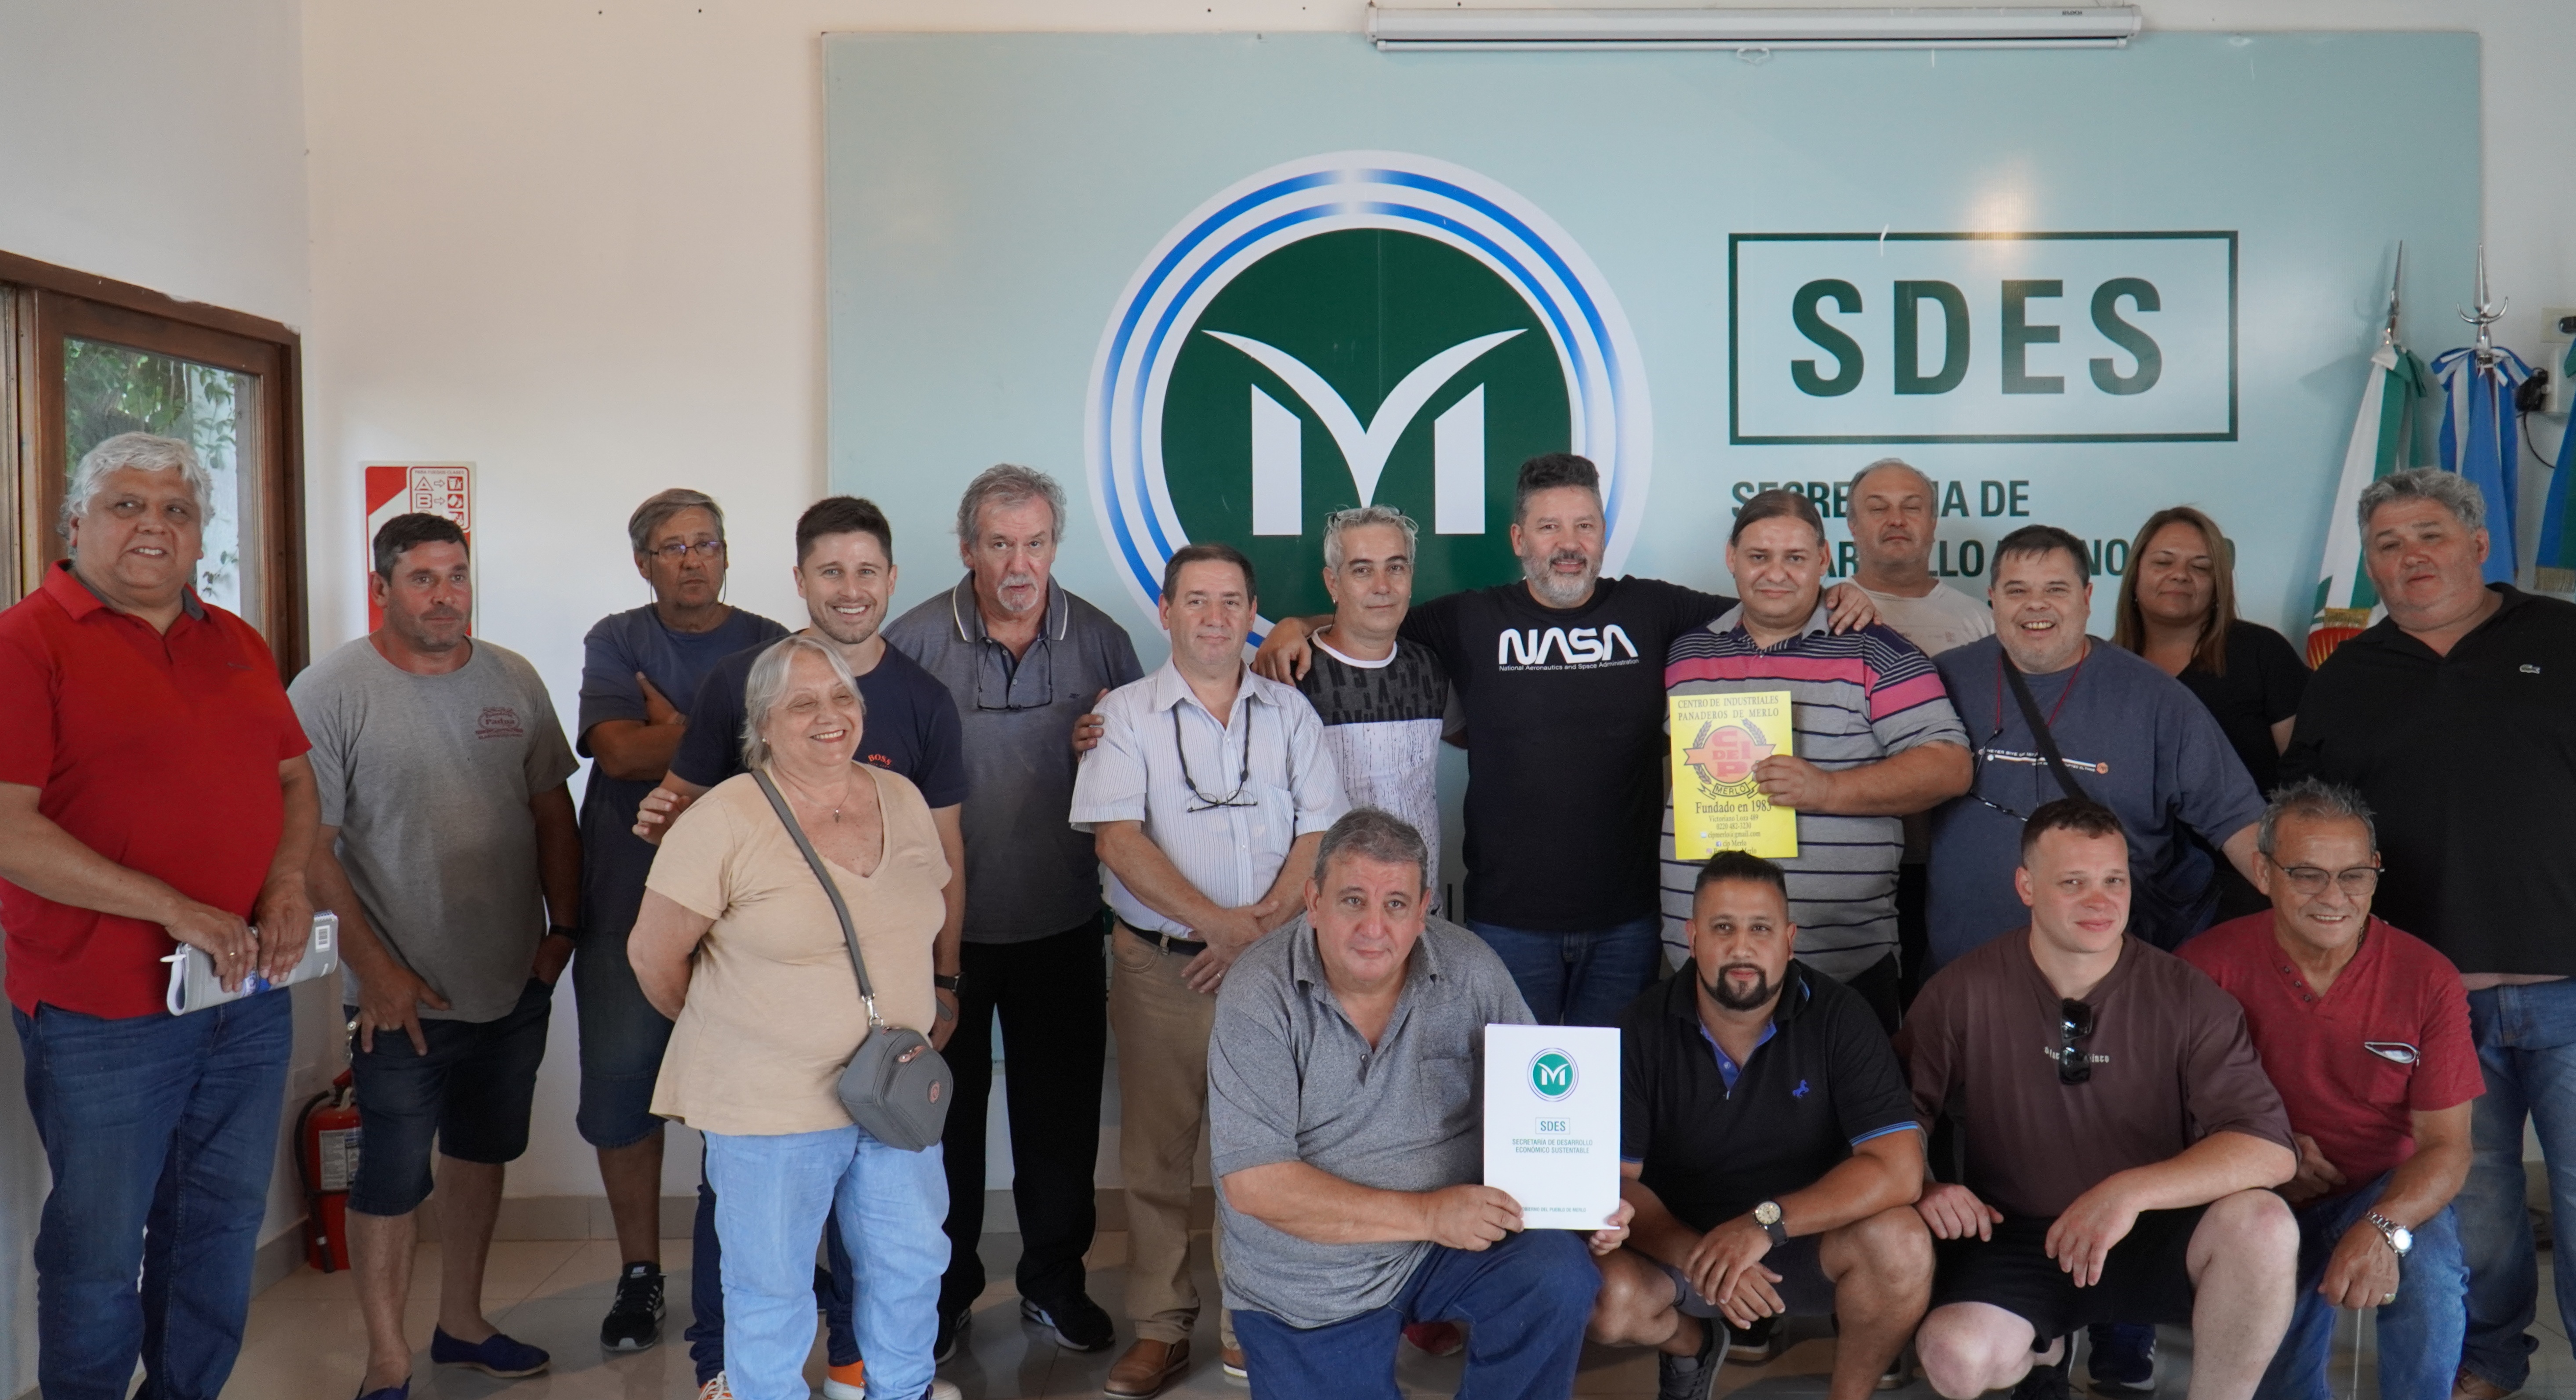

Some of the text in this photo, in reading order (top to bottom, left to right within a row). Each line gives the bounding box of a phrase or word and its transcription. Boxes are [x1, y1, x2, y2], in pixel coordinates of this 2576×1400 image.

[1791, 277, 2162, 397] SDES
[1981, 480, 2030, 518] DE
[1498, 624, 1639, 665] NASA
[1598, 659, 1640, 668] Administration
[1678, 695, 1779, 709] CENTRO DE INDUSTRIALES
[1678, 708, 1779, 721] PANADEROS DE MERLO
[868, 754, 891, 765] BOSS
[1715, 785, 1746, 795] MERLO
[1695, 801, 1735, 813] Fundado
[1738, 804, 1748, 812] en
[1540, 1121, 1566, 1132] SDES
